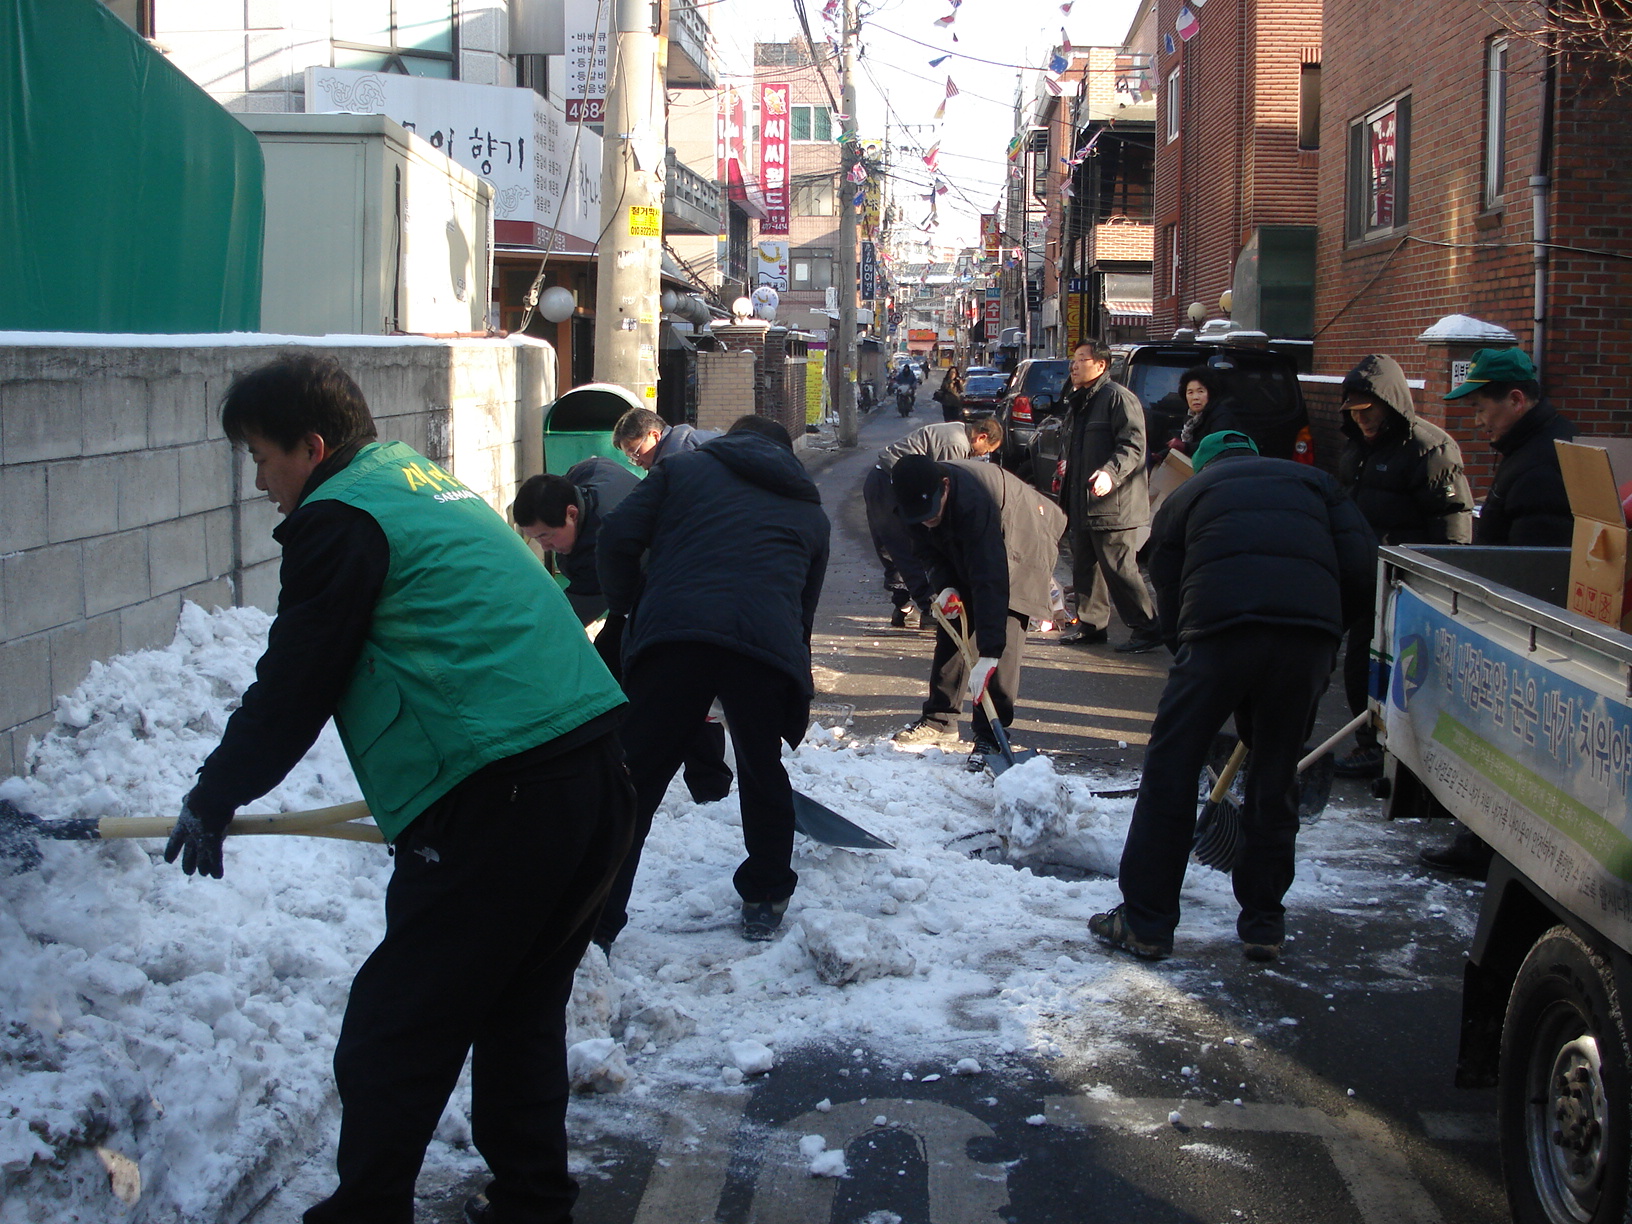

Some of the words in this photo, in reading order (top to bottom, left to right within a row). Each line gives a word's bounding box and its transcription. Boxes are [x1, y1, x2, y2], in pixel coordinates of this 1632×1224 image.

[469, 127, 525, 175] 향기
[764, 119, 785, 210] 씨씨월드
[1457, 642, 1508, 728] 내점포앞
[1509, 669, 1539, 747] 눈은
[1543, 690, 1575, 770] 내가
